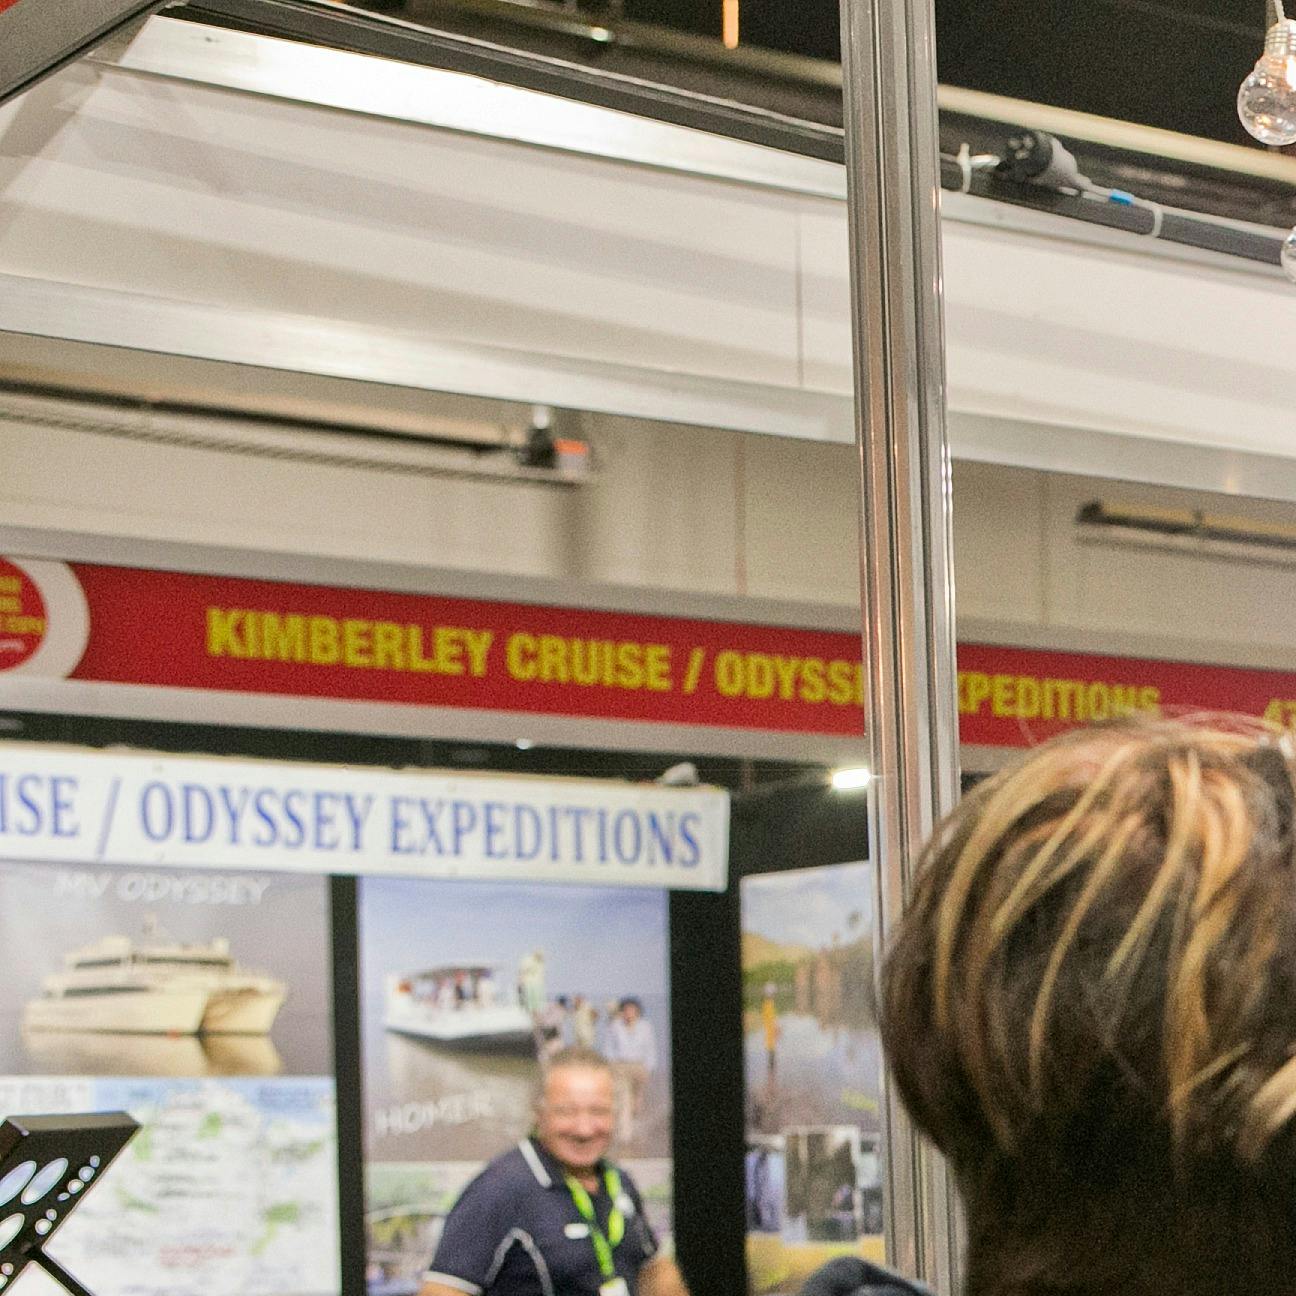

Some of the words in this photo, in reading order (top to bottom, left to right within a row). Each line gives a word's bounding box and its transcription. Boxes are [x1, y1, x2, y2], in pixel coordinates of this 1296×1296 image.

[206, 607, 494, 677] KIMBERLEY
[506, 632, 672, 692] CRUISE
[684, 648, 705, 694] /
[715, 651, 863, 706] ODYSS
[957, 671, 1162, 721] PEDITIONS
[96, 776, 123, 858] /
[140, 779, 376, 852] ODYSSEY
[389, 796, 700, 869] EXPEDITIONS
[118, 873, 271, 905] ODYSSEY
